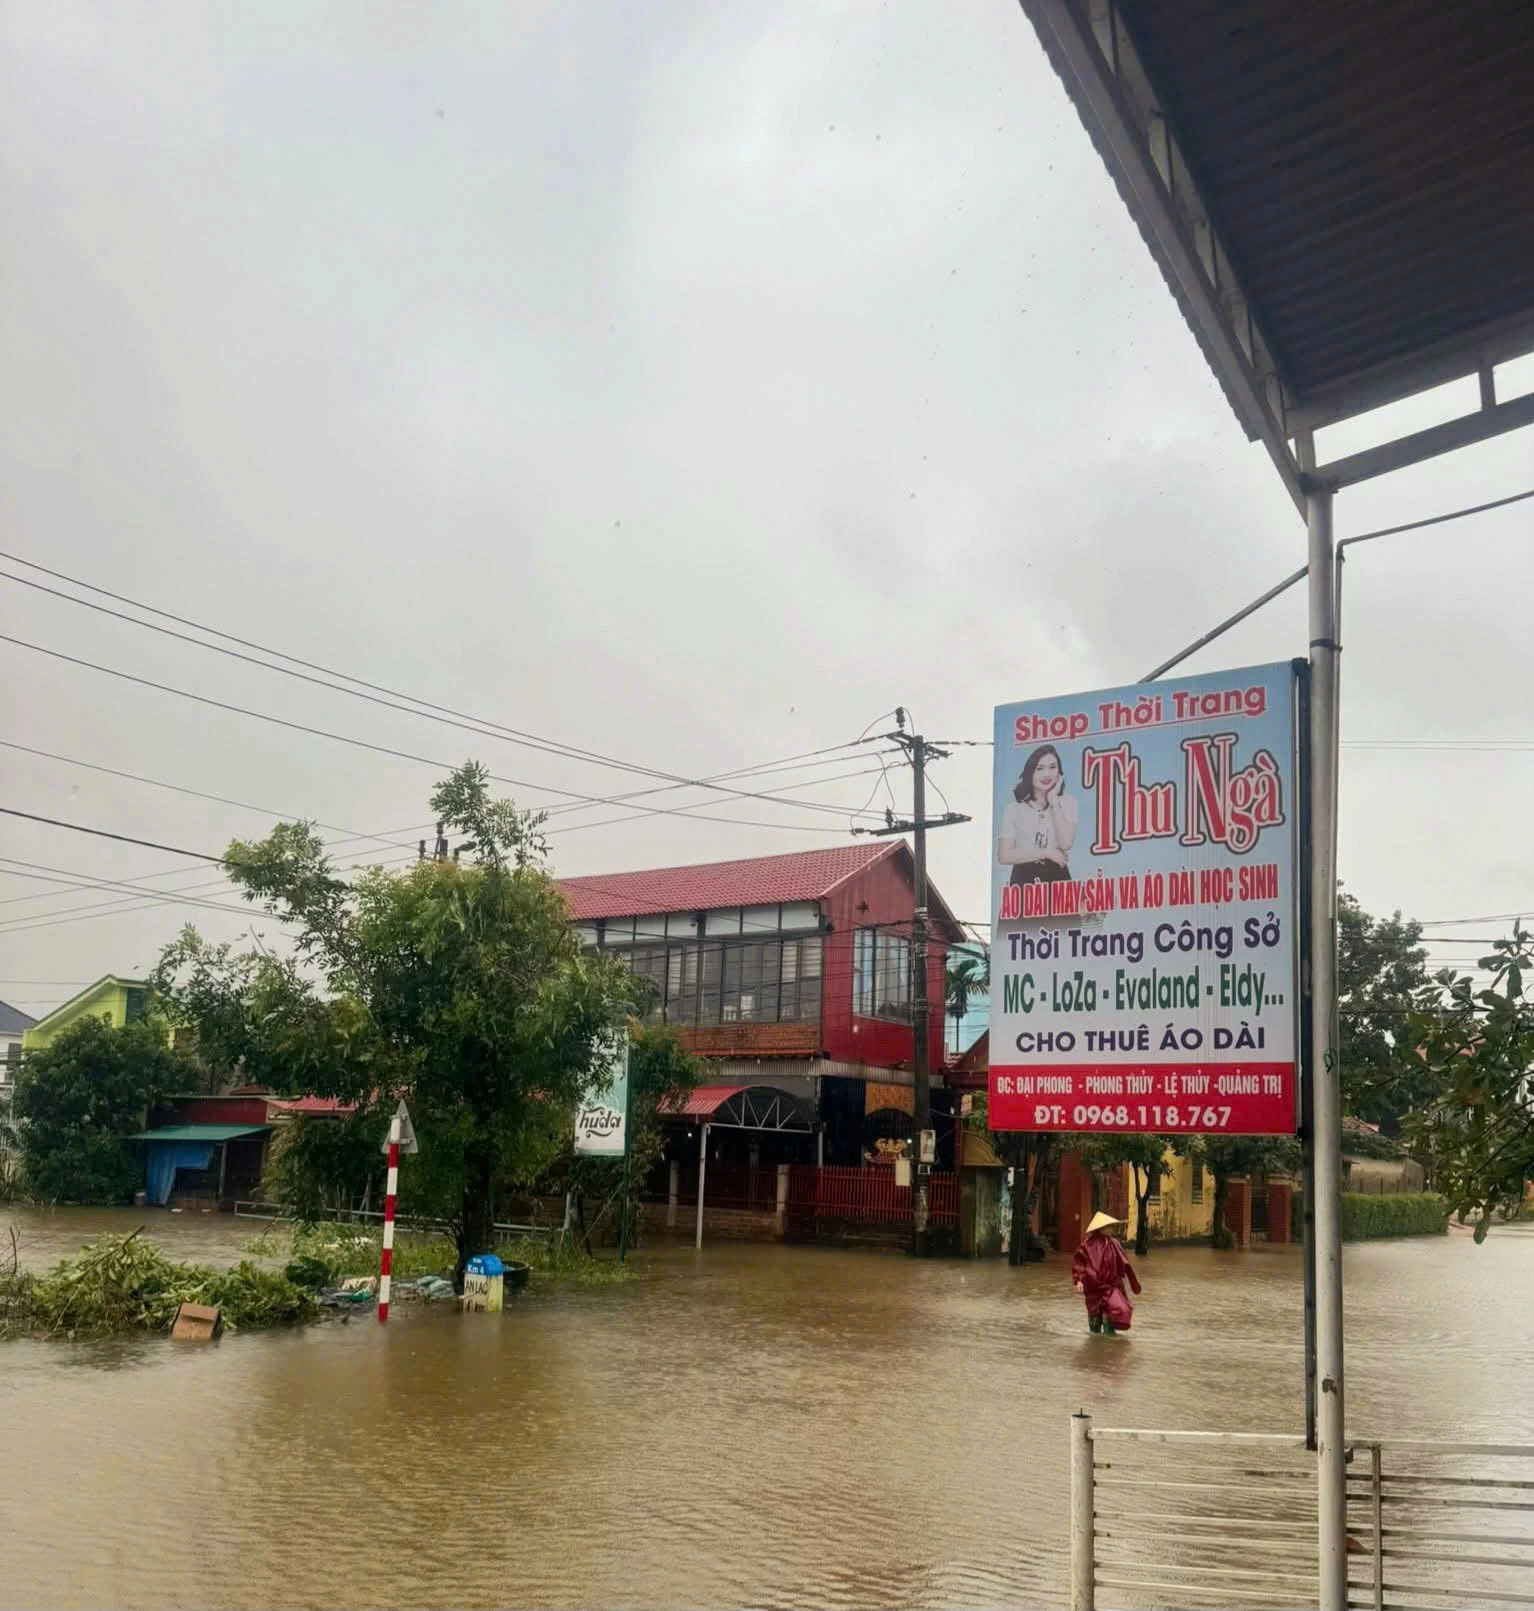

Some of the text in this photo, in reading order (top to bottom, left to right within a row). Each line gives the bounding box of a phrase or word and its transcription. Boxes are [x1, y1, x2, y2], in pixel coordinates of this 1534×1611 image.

[1014, 685, 1267, 742] Shop Thời Trang
[1083, 732, 1286, 855] Thu Ngà
[1001, 881, 1021, 919] ÁO
[1023, 877, 1049, 918] DÀI
[1051, 880, 1082, 916] MAY
[1119, 870, 1139, 910] VÀ
[1143, 868, 1164, 908] ÁO
[1168, 865, 1195, 906] DÀI
[1199, 867, 1234, 910] HỌC
[1239, 863, 1279, 901] SINH
[1007, 911, 1280, 963] Thời Trang Công Sở
[1003, 972, 1035, 1014] MC
[1052, 971, 1097, 1012] LoZa
[1115, 965, 1200, 1010] Evaland
[1220, 963, 1284, 1016] Eldy...
[1016, 1020, 1265, 1053] CHO THUÊ ÁO DÀI
[997, 1076, 1015, 1095] ĐC:
[1016, 1076, 1034, 1098] ĐẠI
[1036, 1076, 1073, 1095] PHONG
[1126, 1069, 1154, 1095] THỦY
[1164, 1071, 1179, 1099] LỆ
[1181, 1069, 1210, 1095] THỦY
[1262, 1074, 1283, 1099] TRỊ
[1034, 1105, 1232, 1126] ĐT: 0968.118.767
